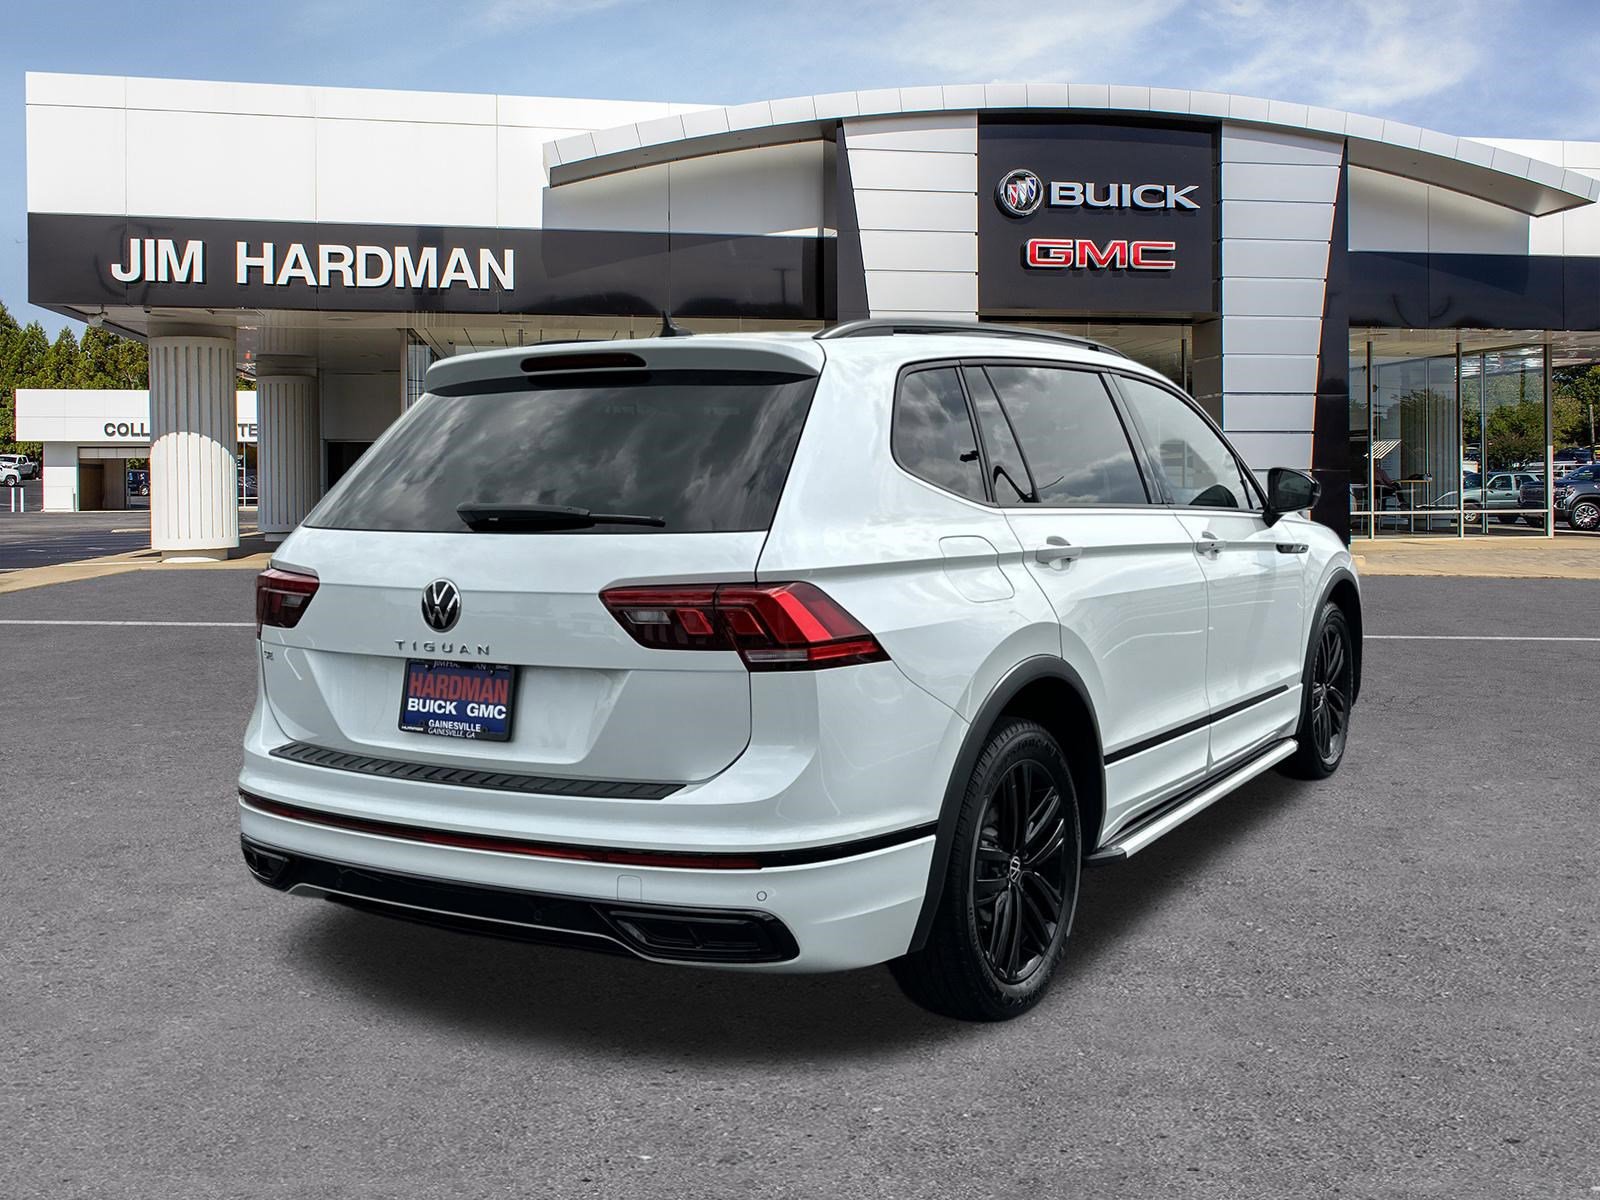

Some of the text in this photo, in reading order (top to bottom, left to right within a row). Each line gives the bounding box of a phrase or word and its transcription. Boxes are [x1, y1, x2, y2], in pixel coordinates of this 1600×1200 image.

[1049, 181, 1201, 209] BUICK
[110, 238, 515, 291] JIM HARDMAN
[1025, 238, 1177, 270] GMC
[394, 639, 491, 656] TIGUAN
[408, 671, 510, 705] HARDMAN
[407, 697, 507, 719] BUICK GMC
[428, 719, 481, 733] GAINESVILLE
